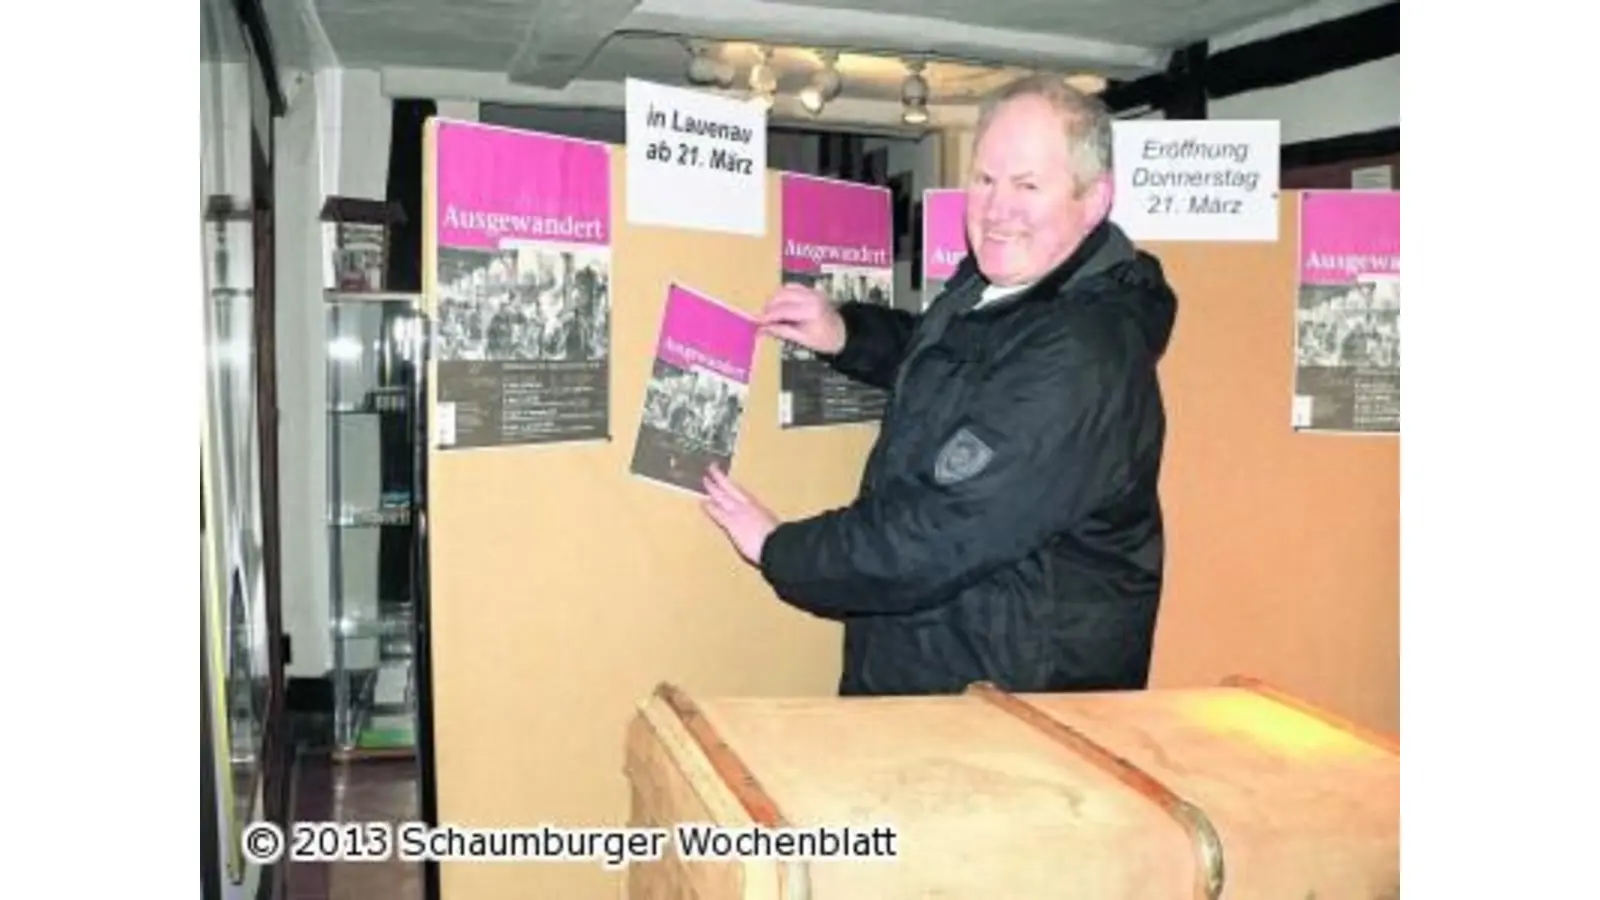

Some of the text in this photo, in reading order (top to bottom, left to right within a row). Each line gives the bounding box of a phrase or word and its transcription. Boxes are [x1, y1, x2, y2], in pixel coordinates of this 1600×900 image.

[647, 104, 753, 143] in Lauenau
[646, 140, 753, 175] ab 21. März
[1142, 139, 1250, 163] Eröffnung
[1132, 167, 1260, 190] Donnerstag
[1147, 195, 1243, 214] 21. März
[442, 203, 604, 239] Ausgewandert
[784, 239, 886, 265] Ausgewandert
